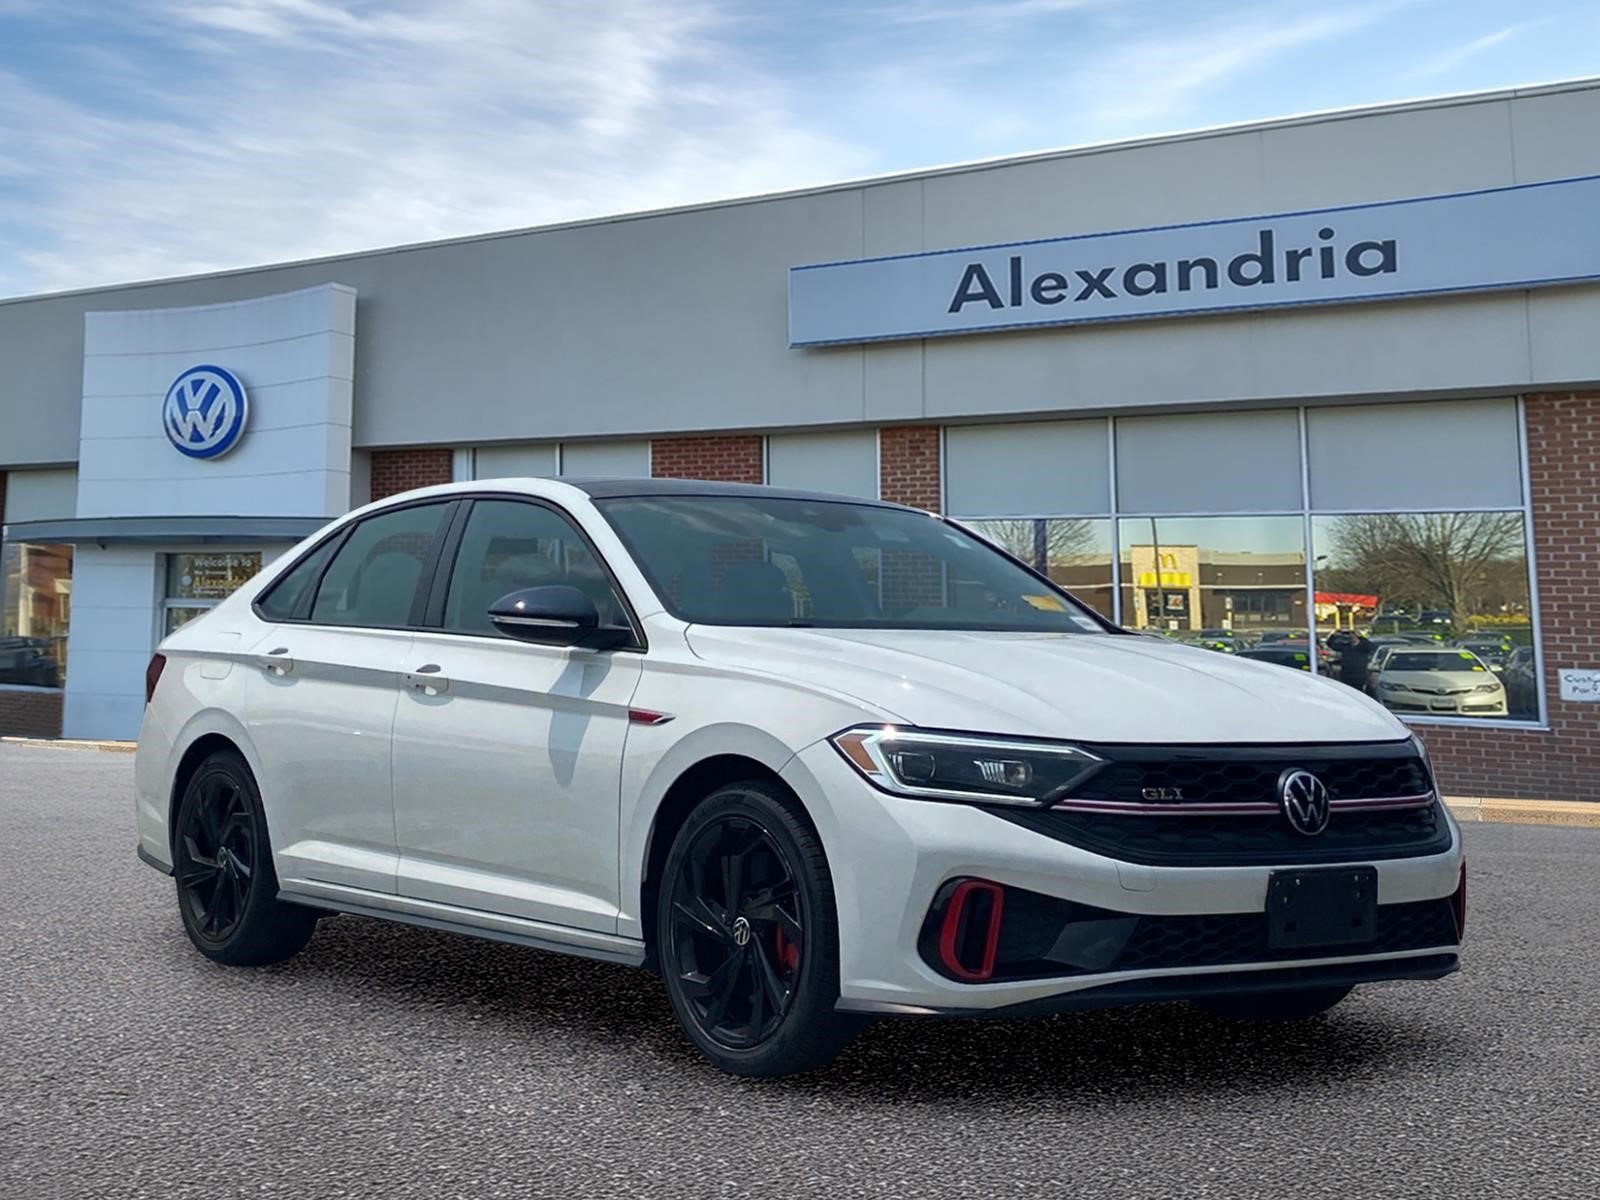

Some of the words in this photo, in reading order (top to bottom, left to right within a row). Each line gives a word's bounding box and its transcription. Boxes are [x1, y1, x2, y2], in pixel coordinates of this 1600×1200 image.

[948, 227, 1398, 314] Alexandria
[194, 558, 239, 567] Welcome
[241, 559, 252, 567] to
[1141, 787, 1184, 801] GLI
